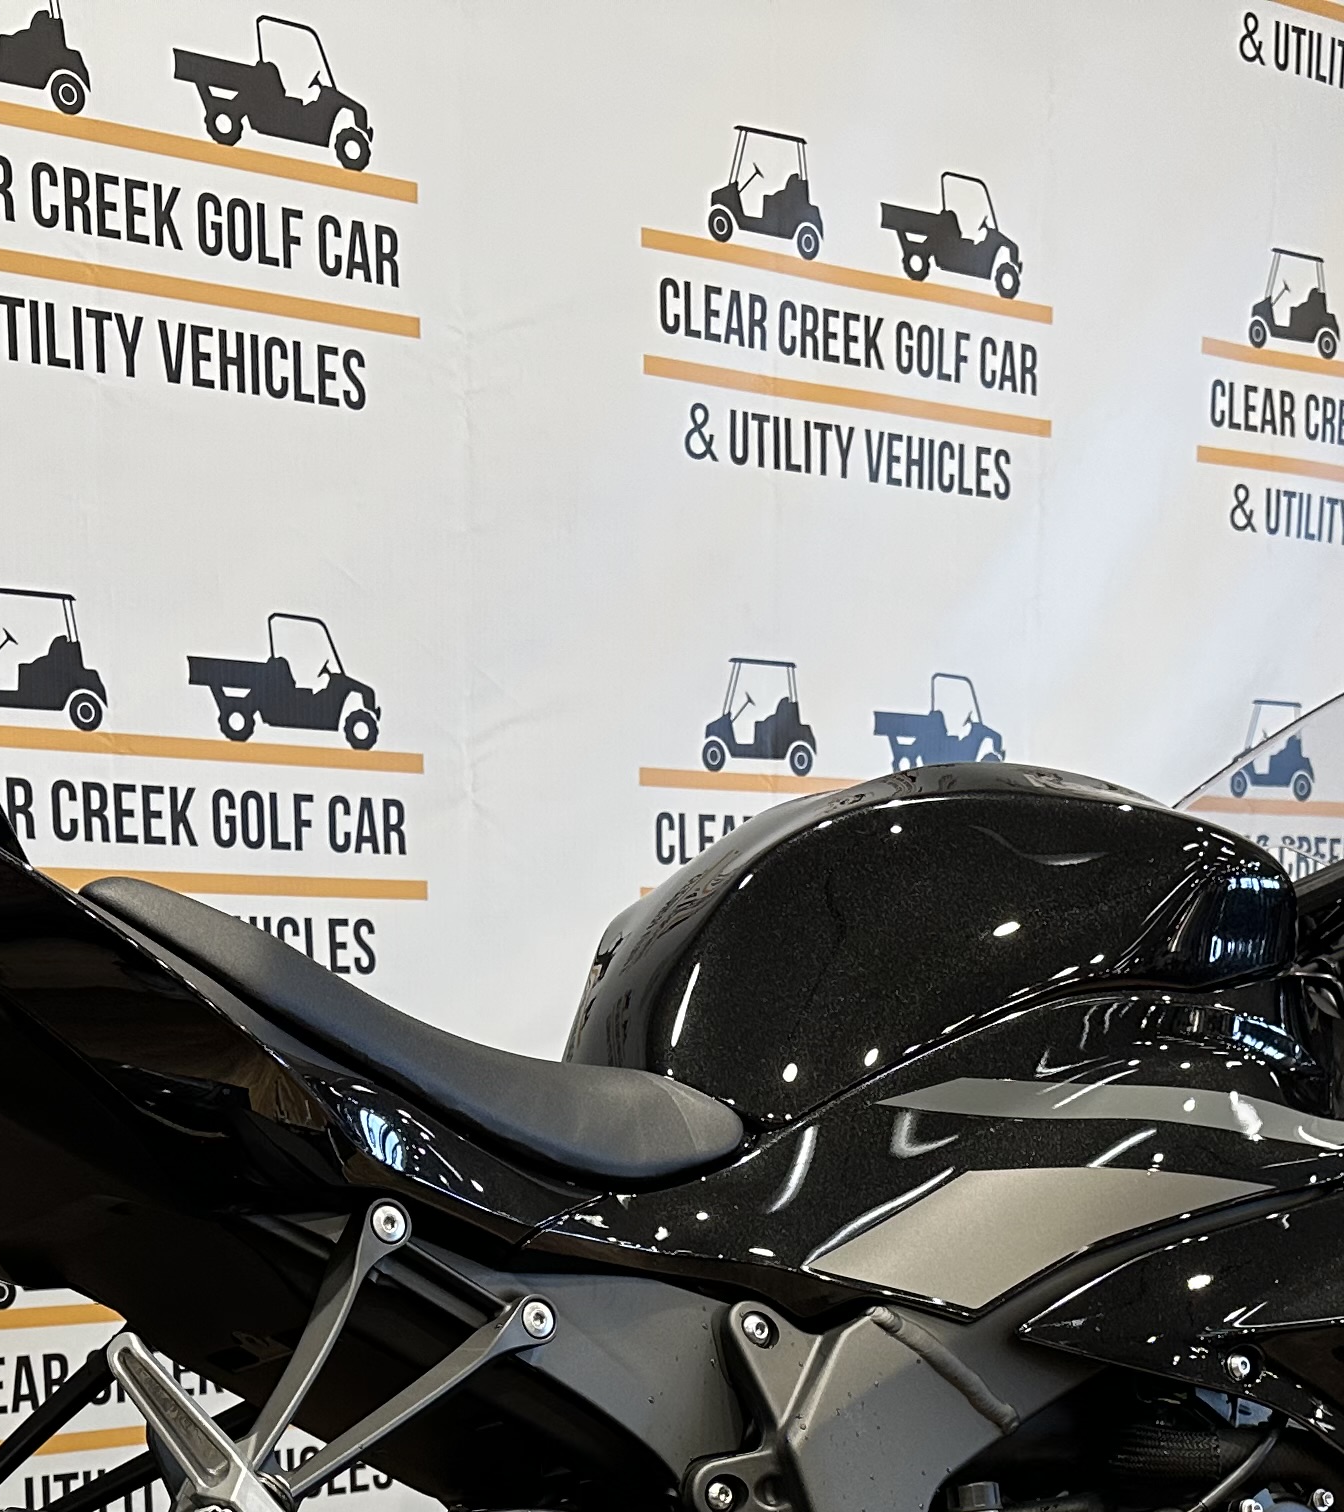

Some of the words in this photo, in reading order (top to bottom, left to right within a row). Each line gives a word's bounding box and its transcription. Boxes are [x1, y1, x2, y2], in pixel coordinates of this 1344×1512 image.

[1240, 12, 1265, 65] &
[32, 162, 183, 250] CREEK
[198, 193, 303, 268] GOLF
[319, 215, 398, 287] CAR
[158, 320, 365, 410] VEHICLES
[660, 278, 766, 350] CLEAR
[779, 301, 884, 370] CREEK
[896, 321, 969, 382] GOLF
[981, 337, 1036, 395] CAR
[1211, 380, 1294, 437] CLEAR
[685, 403, 718, 461] &
[730, 410, 854, 478] UTILITY
[865, 429, 1010, 499] VEHICLES
[1231, 484, 1256, 532] &
[52, 780, 198, 846] CREEK
[213, 789, 313, 851] GOLF
[329, 796, 406, 854] CAR
